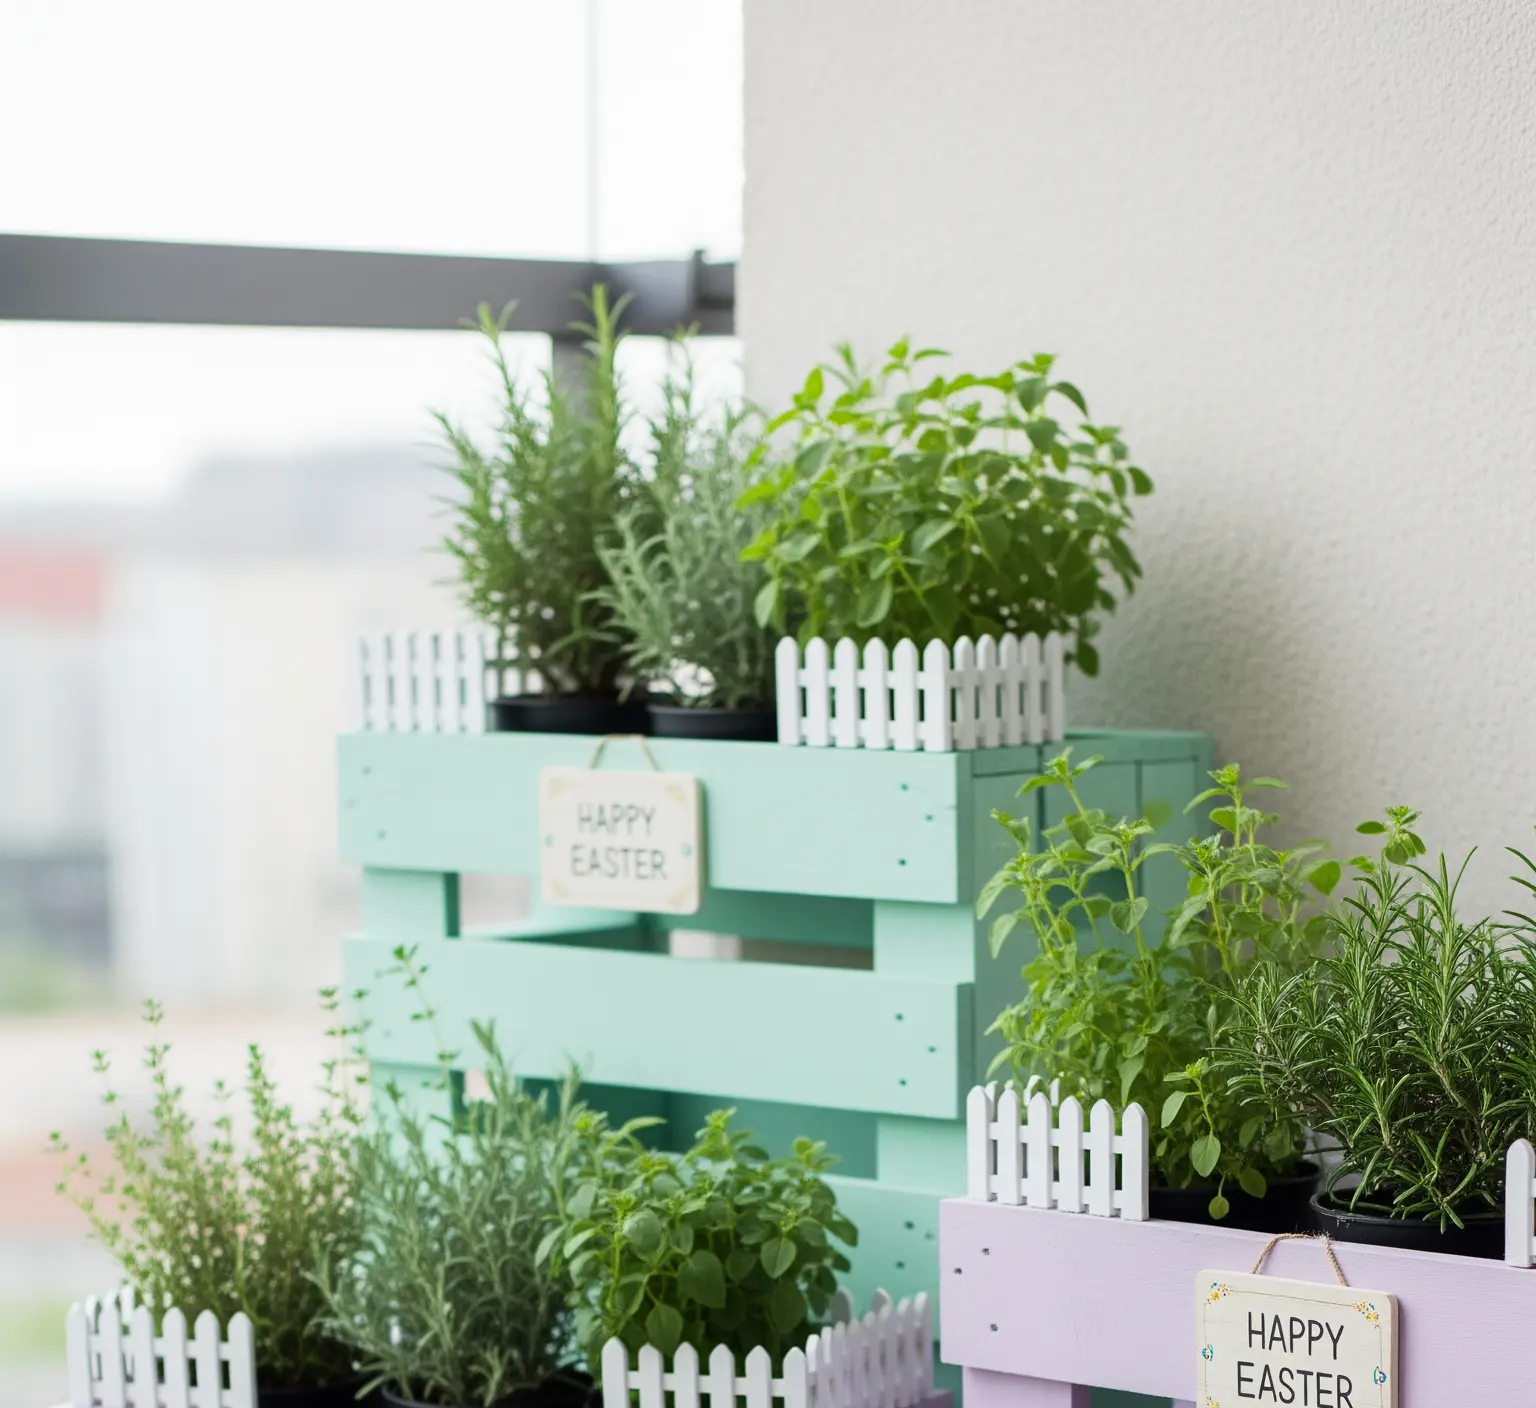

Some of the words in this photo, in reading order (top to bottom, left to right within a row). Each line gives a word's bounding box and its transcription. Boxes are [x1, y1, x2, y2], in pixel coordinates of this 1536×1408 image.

[577, 803, 656, 836] HAPPY
[571, 844, 667, 880] EASTER
[1248, 1311, 1344, 1360] HAPPY
